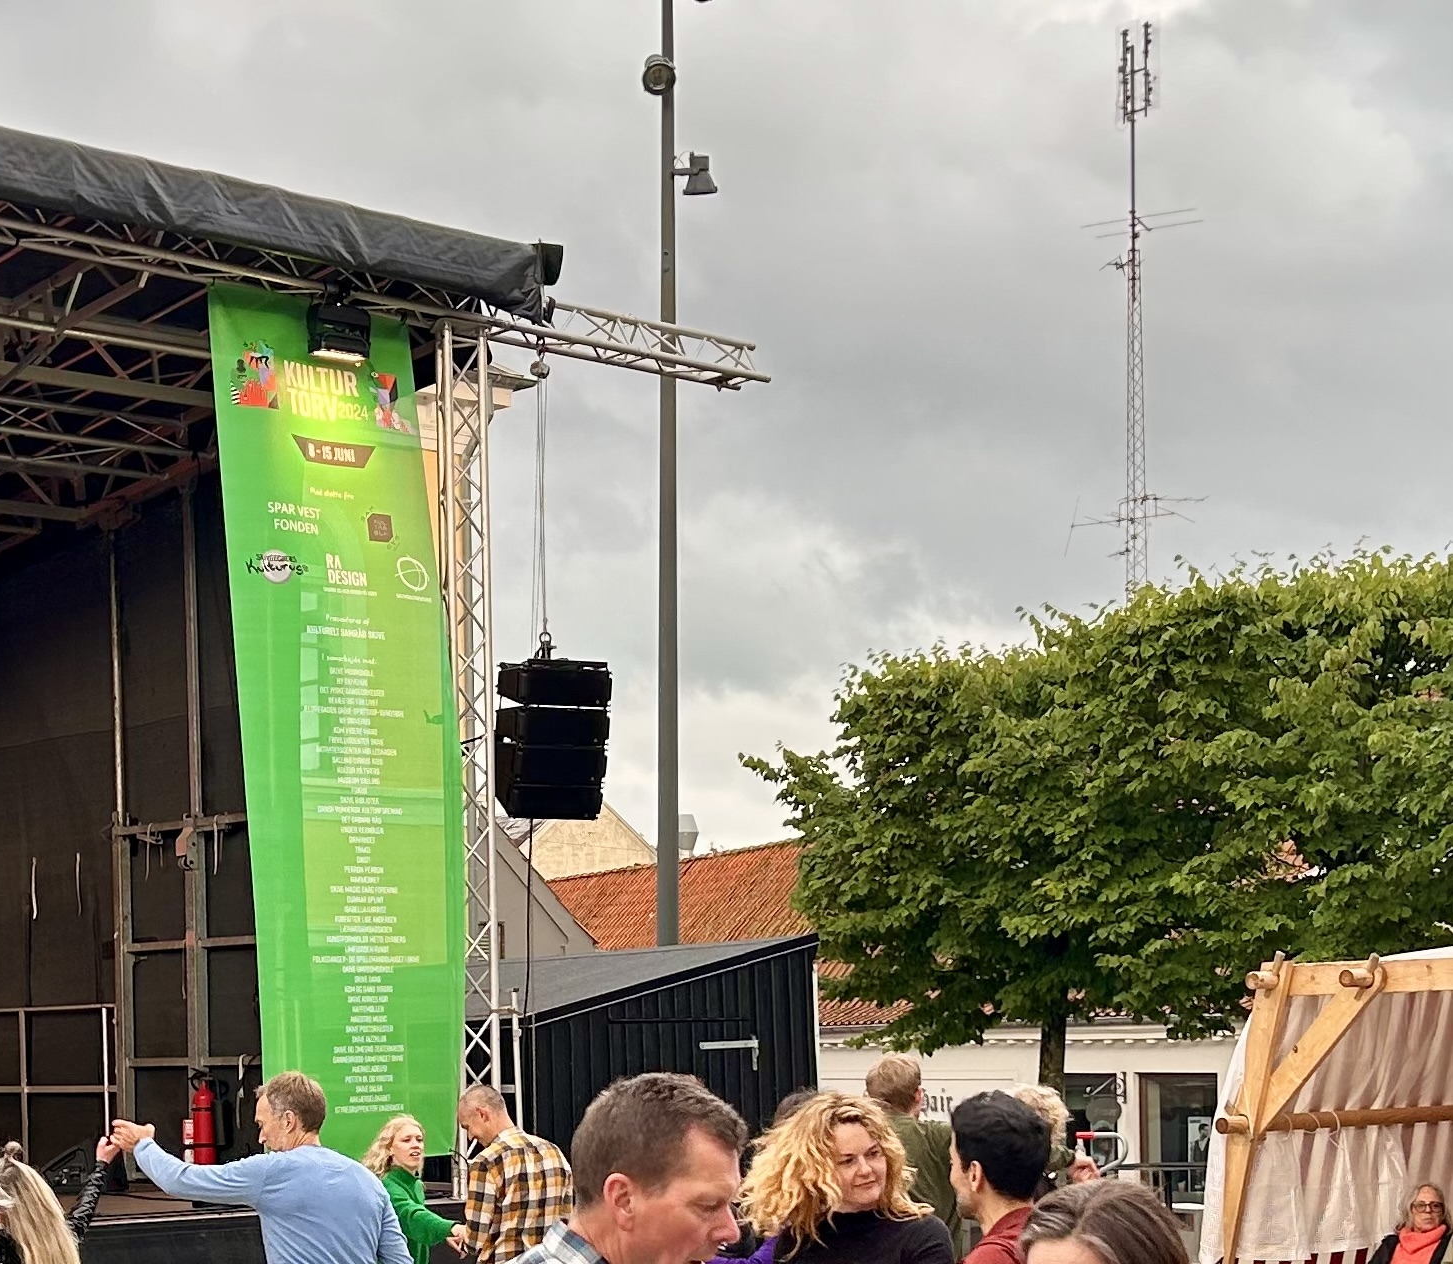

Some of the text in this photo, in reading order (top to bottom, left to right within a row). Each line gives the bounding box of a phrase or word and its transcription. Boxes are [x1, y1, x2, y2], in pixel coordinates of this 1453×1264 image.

[283, 359, 360, 398] KULTUR
[286, 387, 369, 422] TORV 2024
[267, 501, 321, 520] SPAR VEST
[274, 518, 319, 535] FONDEN
[325, 553, 342, 570] RA
[327, 568, 368, 587] DESIGN
